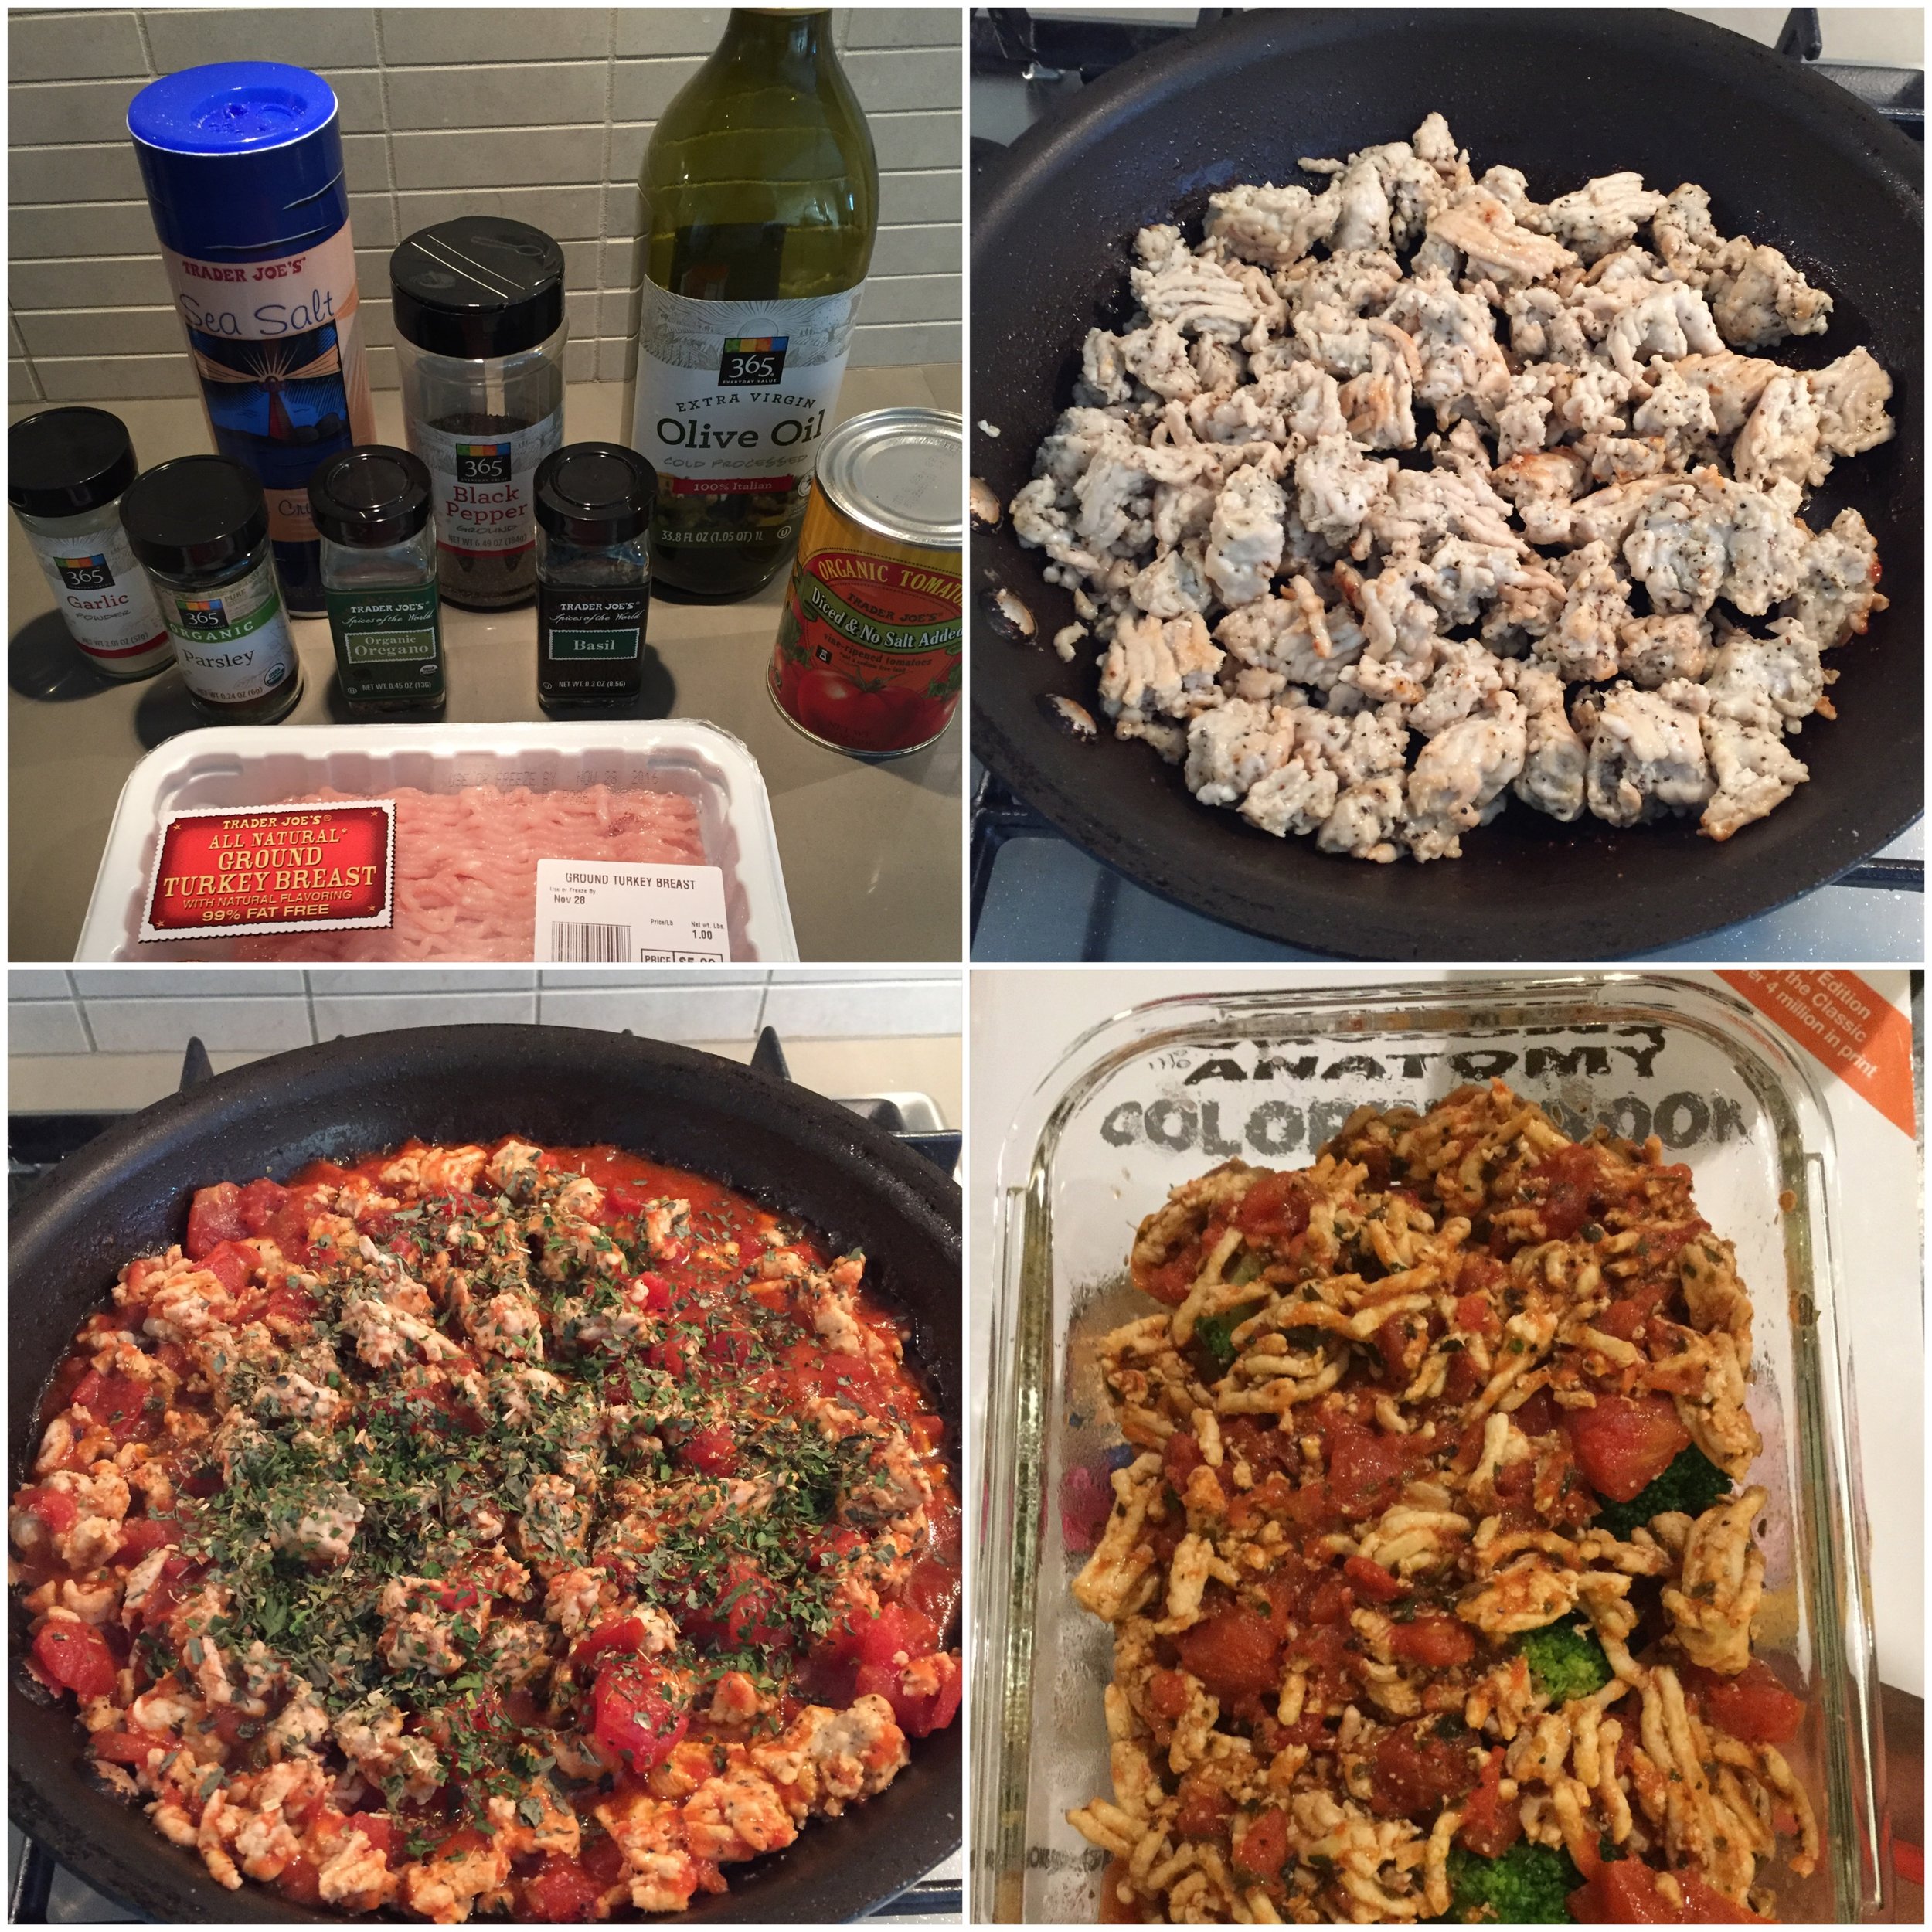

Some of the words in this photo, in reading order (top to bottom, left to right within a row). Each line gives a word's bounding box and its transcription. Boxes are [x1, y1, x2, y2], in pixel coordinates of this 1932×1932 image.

[182, 260, 247, 282] TRADER
[252, 257, 304, 281] JOE'S
[179, 294, 242, 335] Sea
[254, 289, 334, 335] Salt
[729, 354, 775, 378] 365
[676, 393, 740, 413] EXTRA
[750, 393, 817, 410] VIRGIN
[657, 418, 760, 449] Olive
[770, 408, 826, 447] Oil
[464, 458, 502, 477] 365
[664, 456, 706, 468] COLD
[711, 454, 808, 469] PROCESSED
[453, 485, 519, 504] Black
[693, 482, 730, 492] 100%
[732, 481, 773, 491] Italian
[445, 501, 529, 526] Pepper
[456, 525, 518, 535] GROUND
[661, 529, 682, 543] 33.8
[683, 532, 694, 543] FL
[696, 532, 709, 542] OZ
[710, 531, 734, 543] (1.05
[736, 531, 753, 543] QT)
[474, 539, 492, 547] 6.49
[66, 569, 104, 586] 365
[818, 558, 889, 583] ORGANIC
[900, 569, 962, 608] TOMATO
[66, 594, 130, 610] Garlic
[350, 605, 393, 614] TRADER
[395, 603, 425, 612] JOE'S
[605, 602, 634, 611] JOE'S
[847, 592, 896, 621] TRADER
[900, 612, 939, 623] JOE'S
[75, 609, 132, 621] POWDER
[186, 611, 219, 625] 365
[342, 616, 375, 628] Spices
[376, 614, 391, 626] of
[408, 608, 436, 621] World
[549, 613, 583, 624] Spices
[583, 613, 600, 624] of
[595, 613, 611, 621] the
[615, 609, 645, 621] World
[811, 587, 845, 625] Diced
[845, 619, 859, 634] &
[860, 624, 880, 645] No
[884, 631, 913, 648] Salt
[170, 621, 253, 641] ORGANIC
[365, 635, 417, 646] Organic
[355, 645, 430, 657] Oregano
[572, 639, 616, 651] Basil
[824, 634, 883, 663] vine-ripened
[886, 656, 933, 666] tomatoes
[182, 649, 255, 668] Parsley
[389, 682, 403, 690] 0.45
[414, 681, 432, 690] (13G)
[223, 818, 277, 830] TRADER
[281, 815, 321, 826] JOE'S
[209, 833, 246, 850] ALL
[218, 846, 323, 872] GROUND
[164, 871, 272, 898] TURKEY
[274, 866, 377, 891] BREAST
[566, 872, 609, 884] GROUND
[613, 875, 652, 887] TURKEY
[656, 878, 696, 889] BREAST
[183, 898, 215, 910] WITH
[218, 894, 277, 907] NATURAL
[280, 889, 353, 903] FLAVORING
[553, 894, 572, 904] Nov
[573, 895, 586, 905] 28
[202, 908, 241, 922] 99%
[247, 906, 279, 920] FAT
[284, 903, 330, 917] FREE
[692, 930, 713, 940] 1.00
[1817, 970, 1871, 1020] Edition
[1784, 970, 1811, 996] the
[1811, 992, 1867, 1043] Classic
[1745, 970, 1767, 983] er
[1766, 981, 1779, 995] 4
[1775, 991, 1825, 1035] million
[1823, 1029, 1842, 1048] in
[1836, 1045, 1879, 1079] print
[1184, 1041, 1666, 1084] ANATOMY
